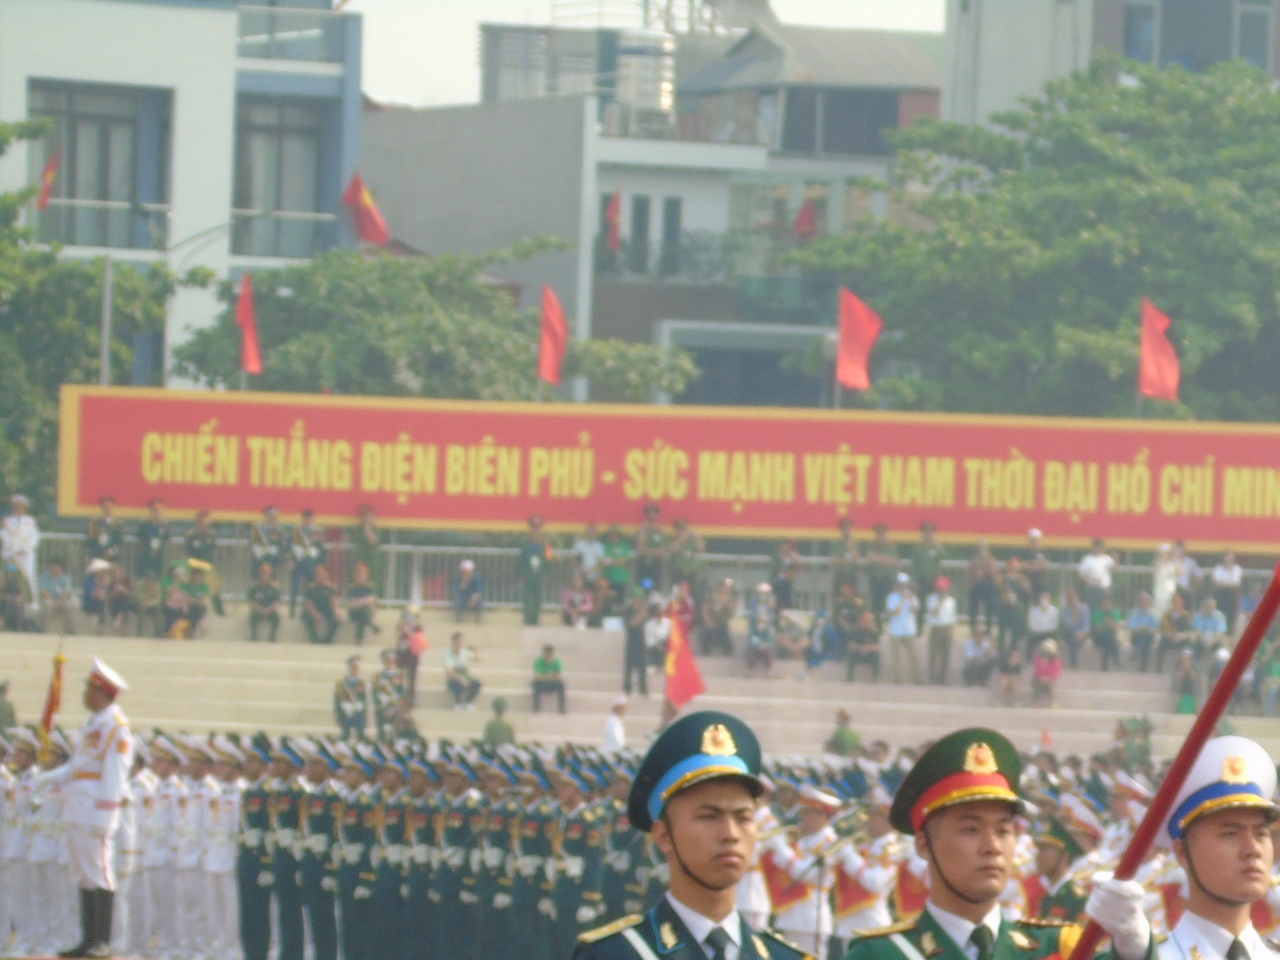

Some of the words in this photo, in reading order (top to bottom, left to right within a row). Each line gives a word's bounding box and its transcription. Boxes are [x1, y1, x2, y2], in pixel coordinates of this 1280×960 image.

[141, 417, 239, 486] CHIẾN
[246, 418, 353, 489] THẮNG
[360, 431, 438, 504] ĐIỆN
[445, 434, 520, 496] BIÊN
[527, 430, 594, 497] PHỦ
[624, 437, 690, 499] SỨC
[698, 450, 794, 514] MẠNH
[803, 442, 873, 516] VIỆT
[878, 454, 955, 506] NAM
[964, 446, 1036, 509] THỜI
[1043, 459, 1098, 523] ĐẠI
[1159, 453, 1214, 516] CHÍ
